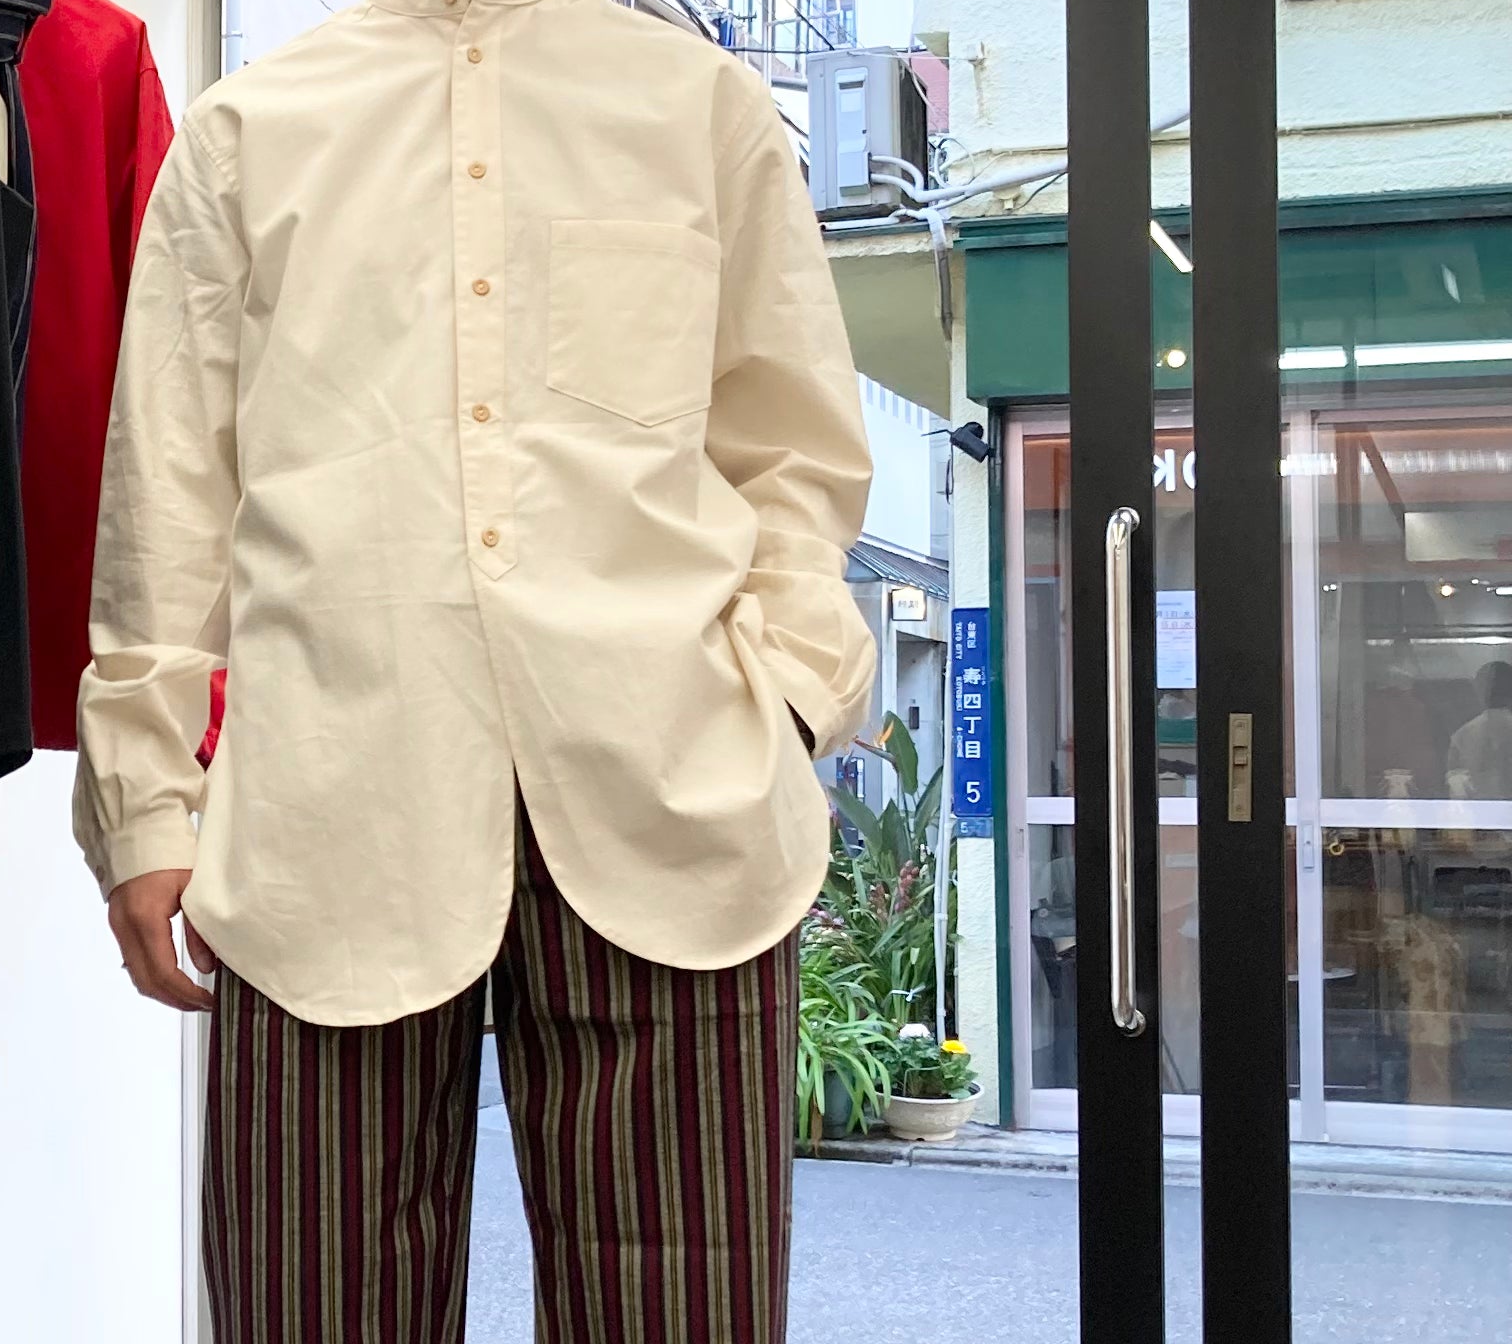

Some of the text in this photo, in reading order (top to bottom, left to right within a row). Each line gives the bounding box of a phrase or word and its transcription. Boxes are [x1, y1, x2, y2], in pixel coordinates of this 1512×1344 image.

[963, 667, 982, 804] 寿四丁目 5
